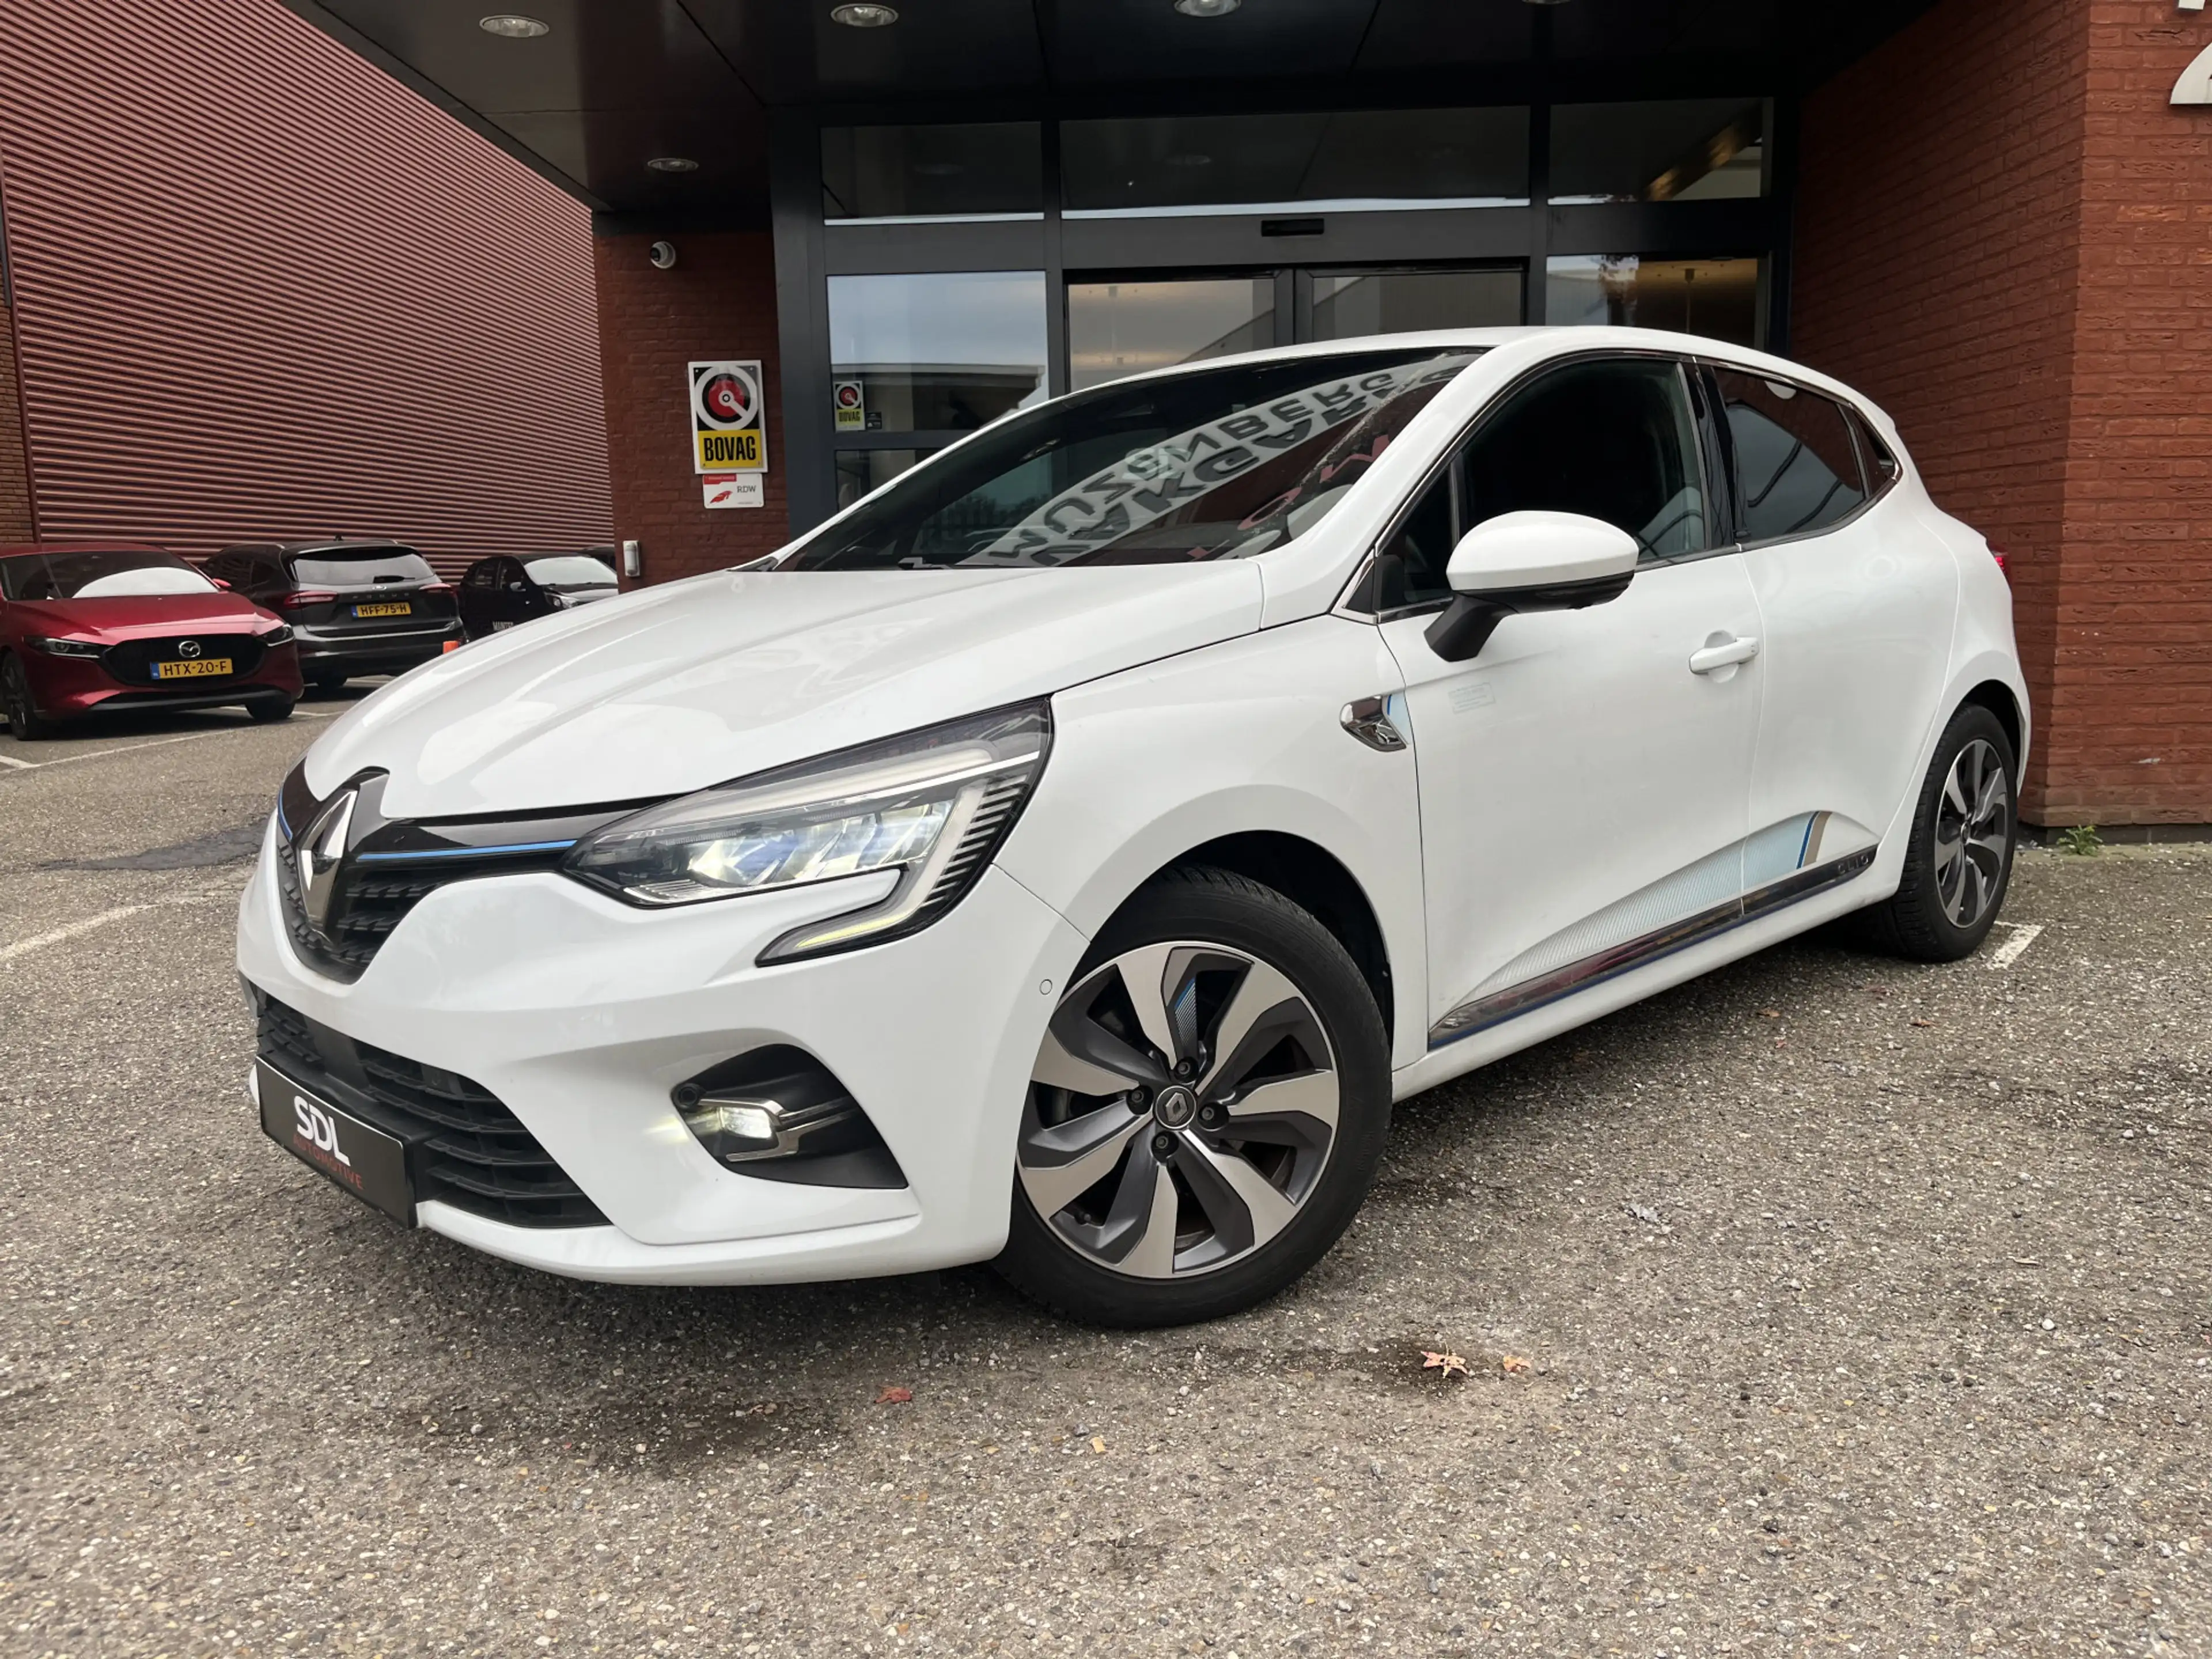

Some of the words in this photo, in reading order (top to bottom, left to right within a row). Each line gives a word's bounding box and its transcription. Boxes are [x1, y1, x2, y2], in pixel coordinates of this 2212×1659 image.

[704, 435, 756, 461] BOVAG
[737, 485, 756, 493] RDW
[361, 604, 407, 615] HFF-75-H
[164, 661, 226, 676] HTX-20-F
[1838, 855, 1869, 874] CLIO
[294, 1095, 351, 1166] SDL
[293, 1132, 364, 1191] AUTOMOTIVE
